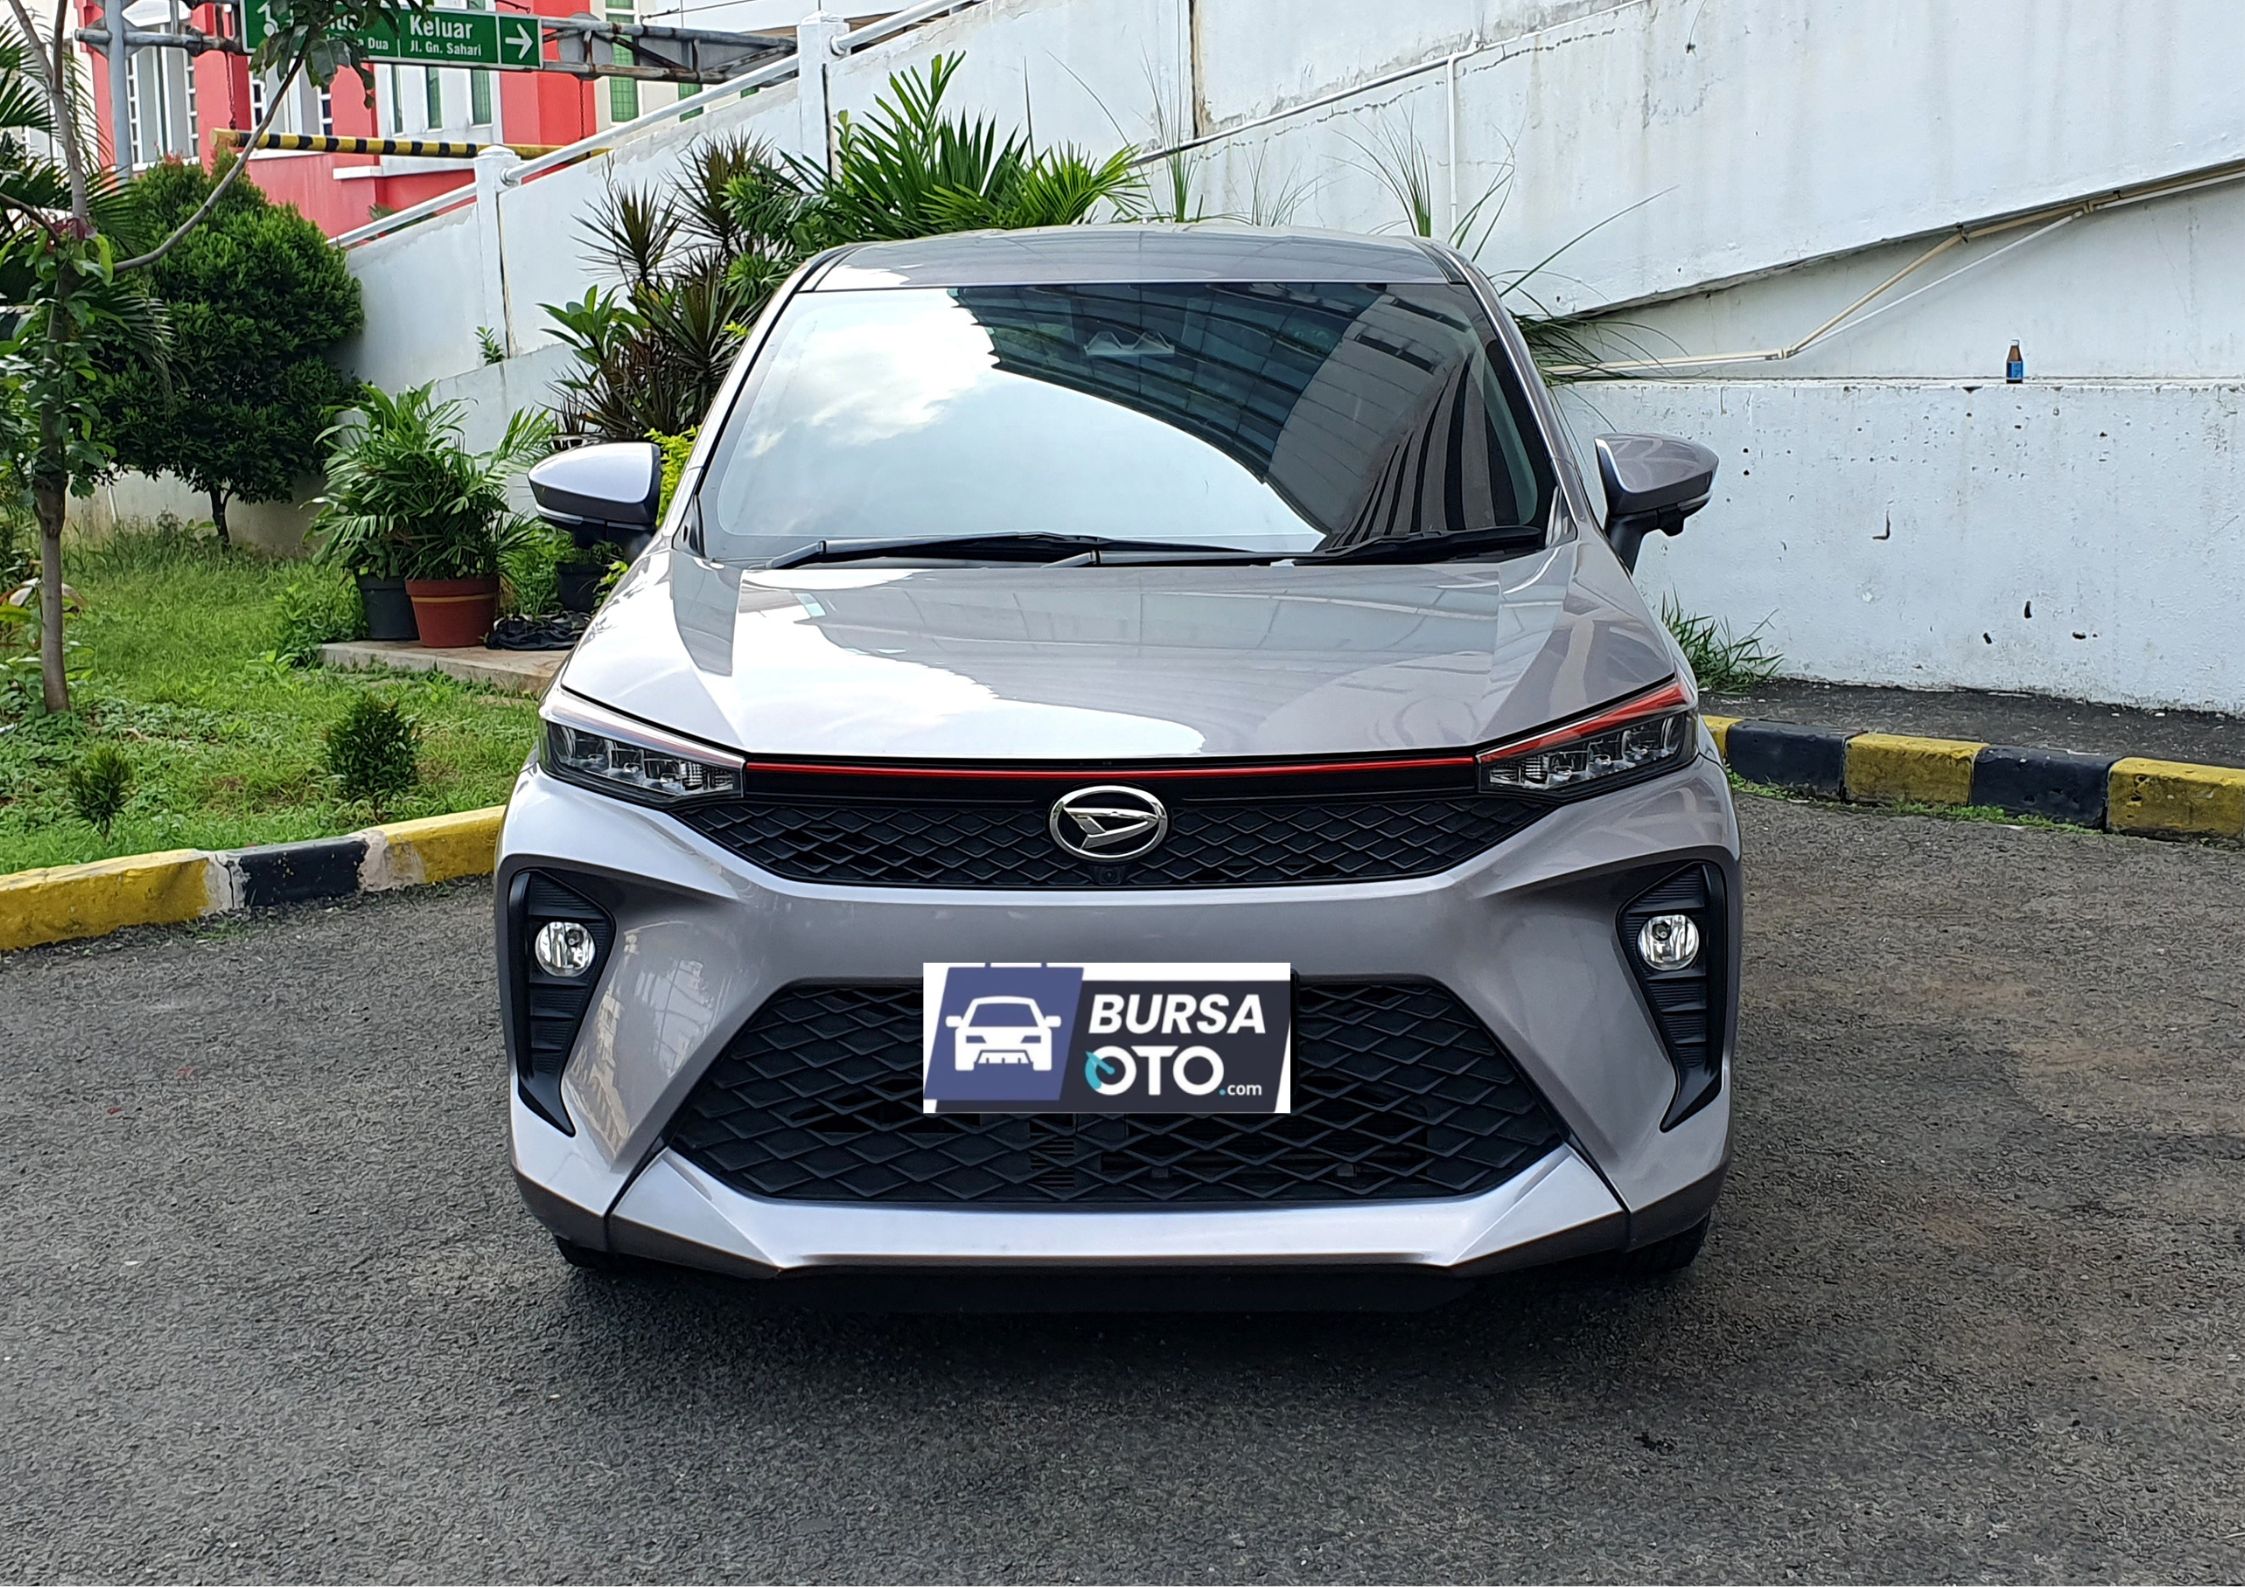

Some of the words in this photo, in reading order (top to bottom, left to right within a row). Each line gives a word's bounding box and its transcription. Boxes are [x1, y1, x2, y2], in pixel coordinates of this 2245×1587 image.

[409, 14, 473, 39] Keluar
[367, 37, 389, 50] Dua
[410, 40, 422, 52] Jl.
[425, 40, 443, 54] Gn.
[446, 42, 482, 56] Sahari
